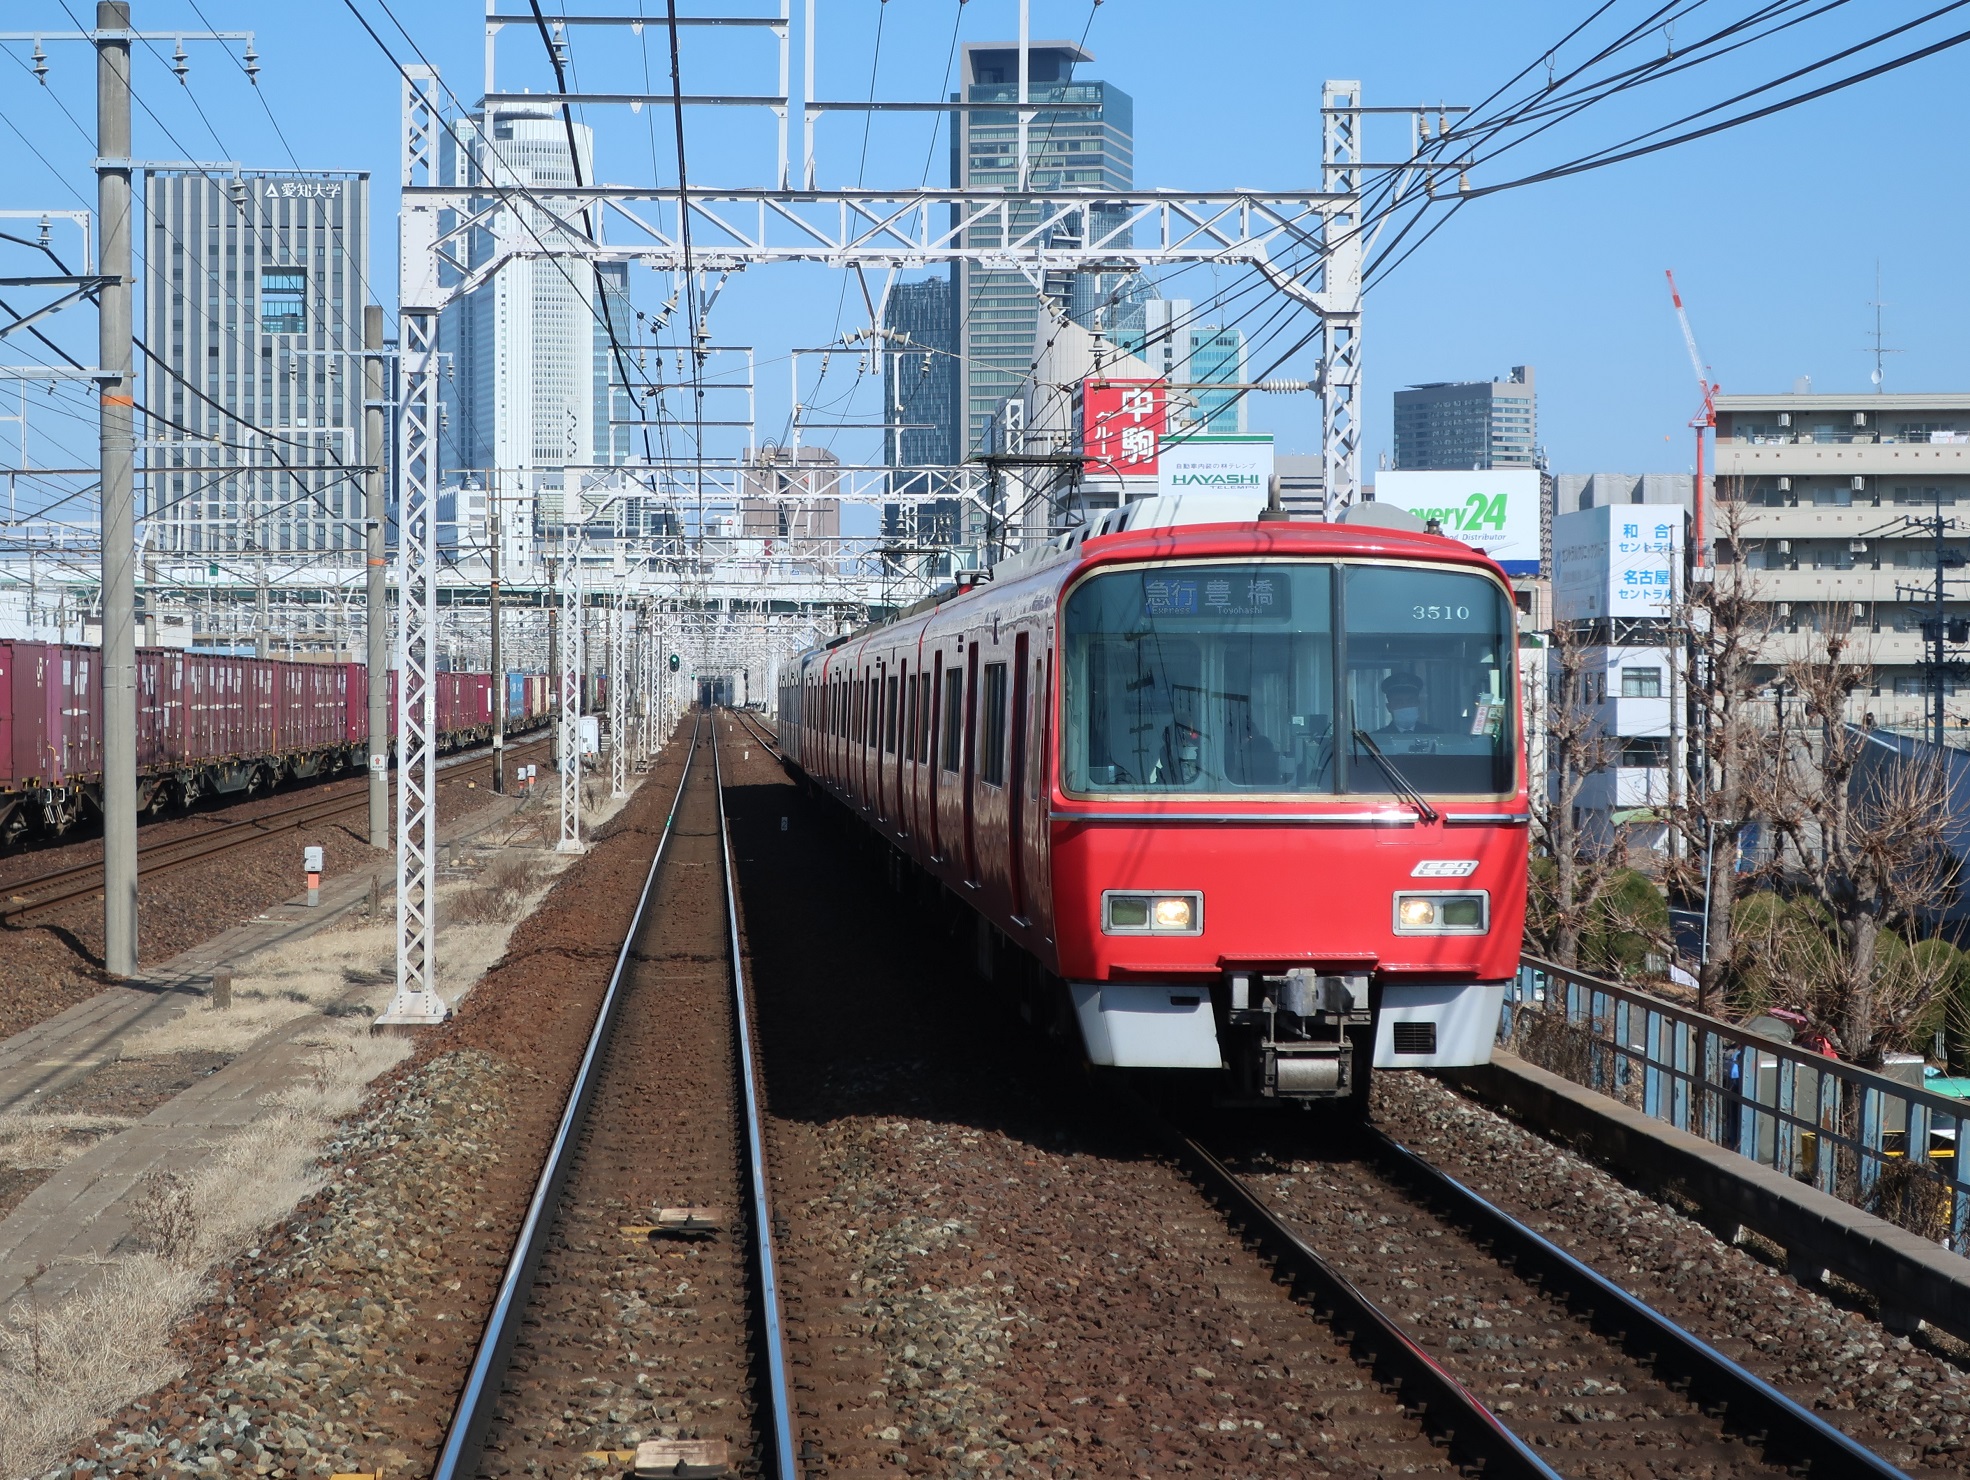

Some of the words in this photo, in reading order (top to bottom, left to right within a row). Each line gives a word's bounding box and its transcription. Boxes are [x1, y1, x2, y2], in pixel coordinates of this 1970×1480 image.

[281, 182, 341, 198] 愛知大学
[1121, 388, 1154, 464] 中駒
[1173, 474, 1259, 485] HAYASHI
[1623, 570, 1670, 585] 名古屋
[1146, 580, 1196, 605] 急行
[1152, 606, 1190, 614] Express
[1217, 606, 1263, 614] Toyohashi
[1412, 606, 1469, 619] 3510
